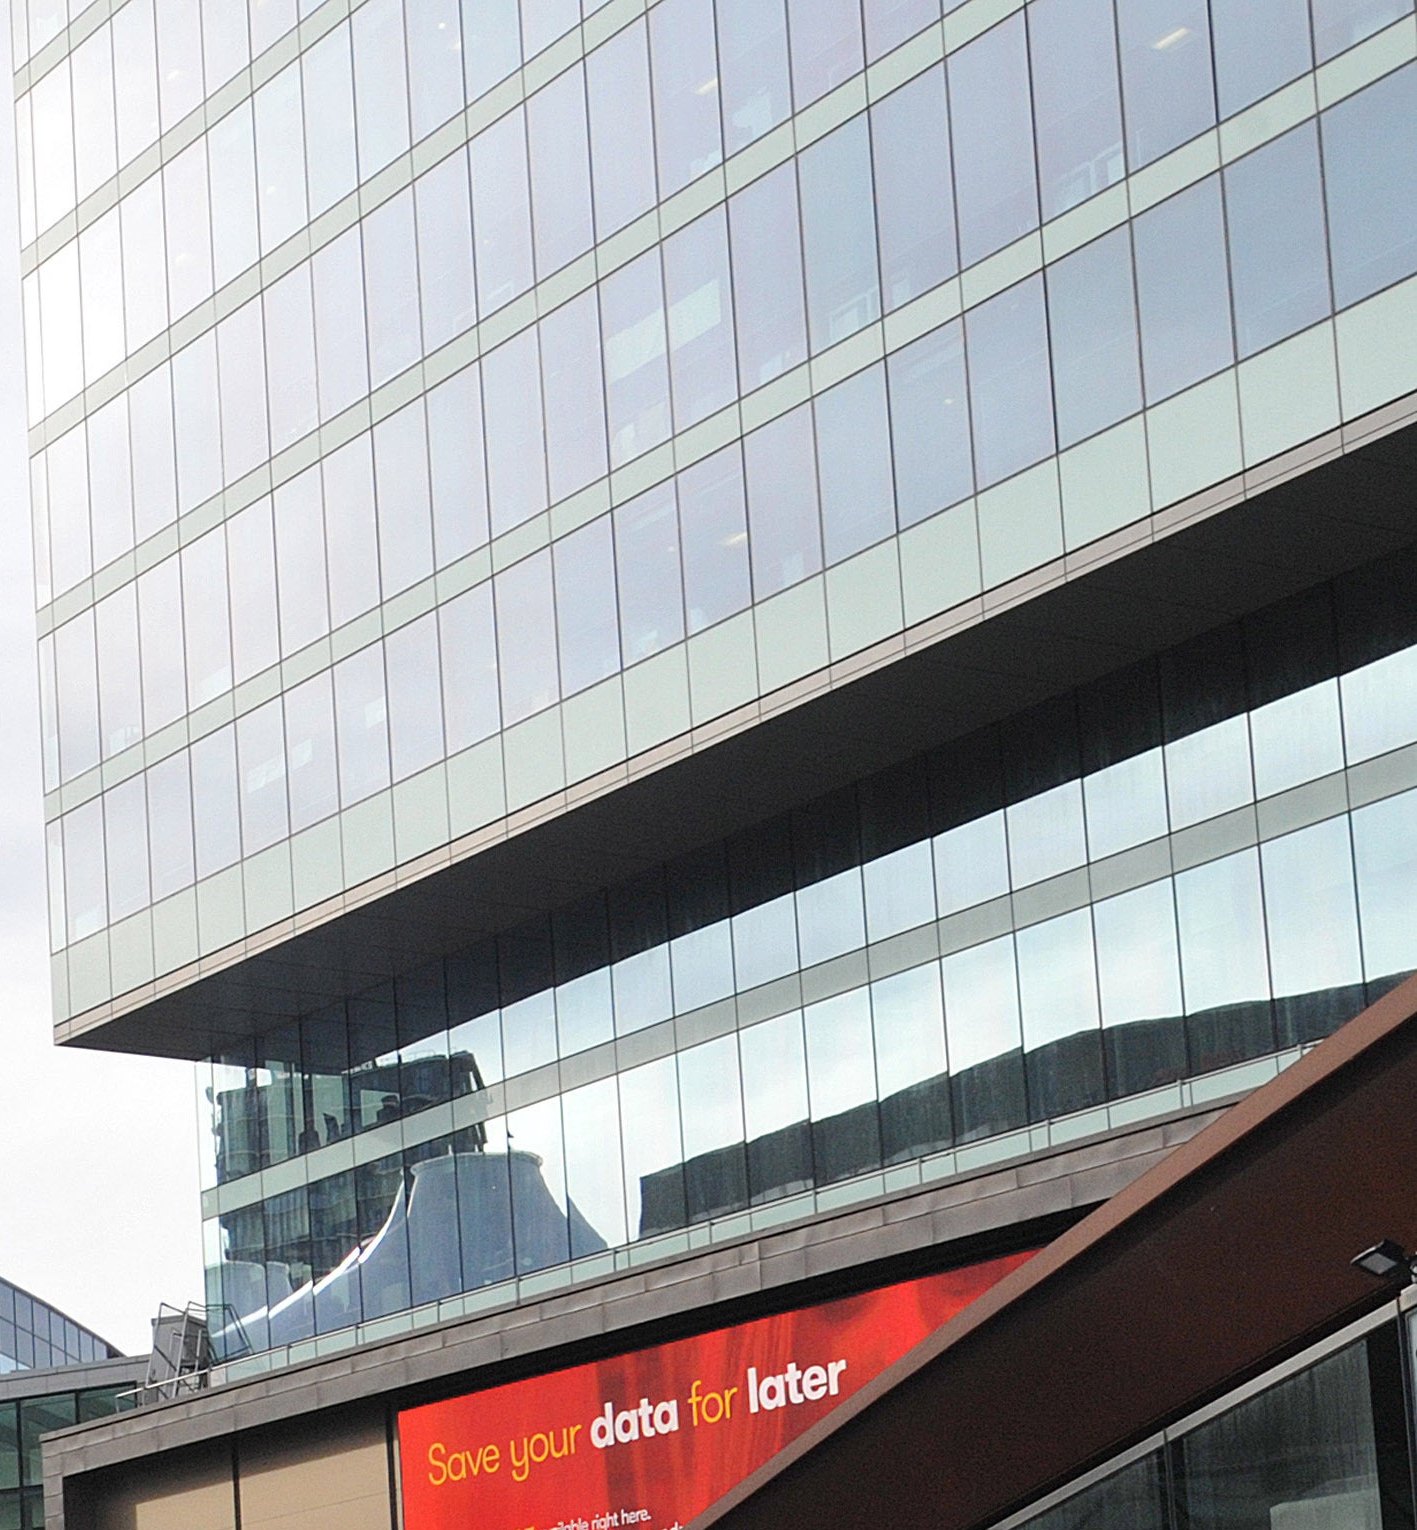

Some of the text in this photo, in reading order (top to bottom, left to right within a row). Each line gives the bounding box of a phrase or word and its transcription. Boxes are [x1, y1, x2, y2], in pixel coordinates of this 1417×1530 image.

[428, 1359, 848, 1486] Save your data for later
[621, 1507, 652, 1526] here.
